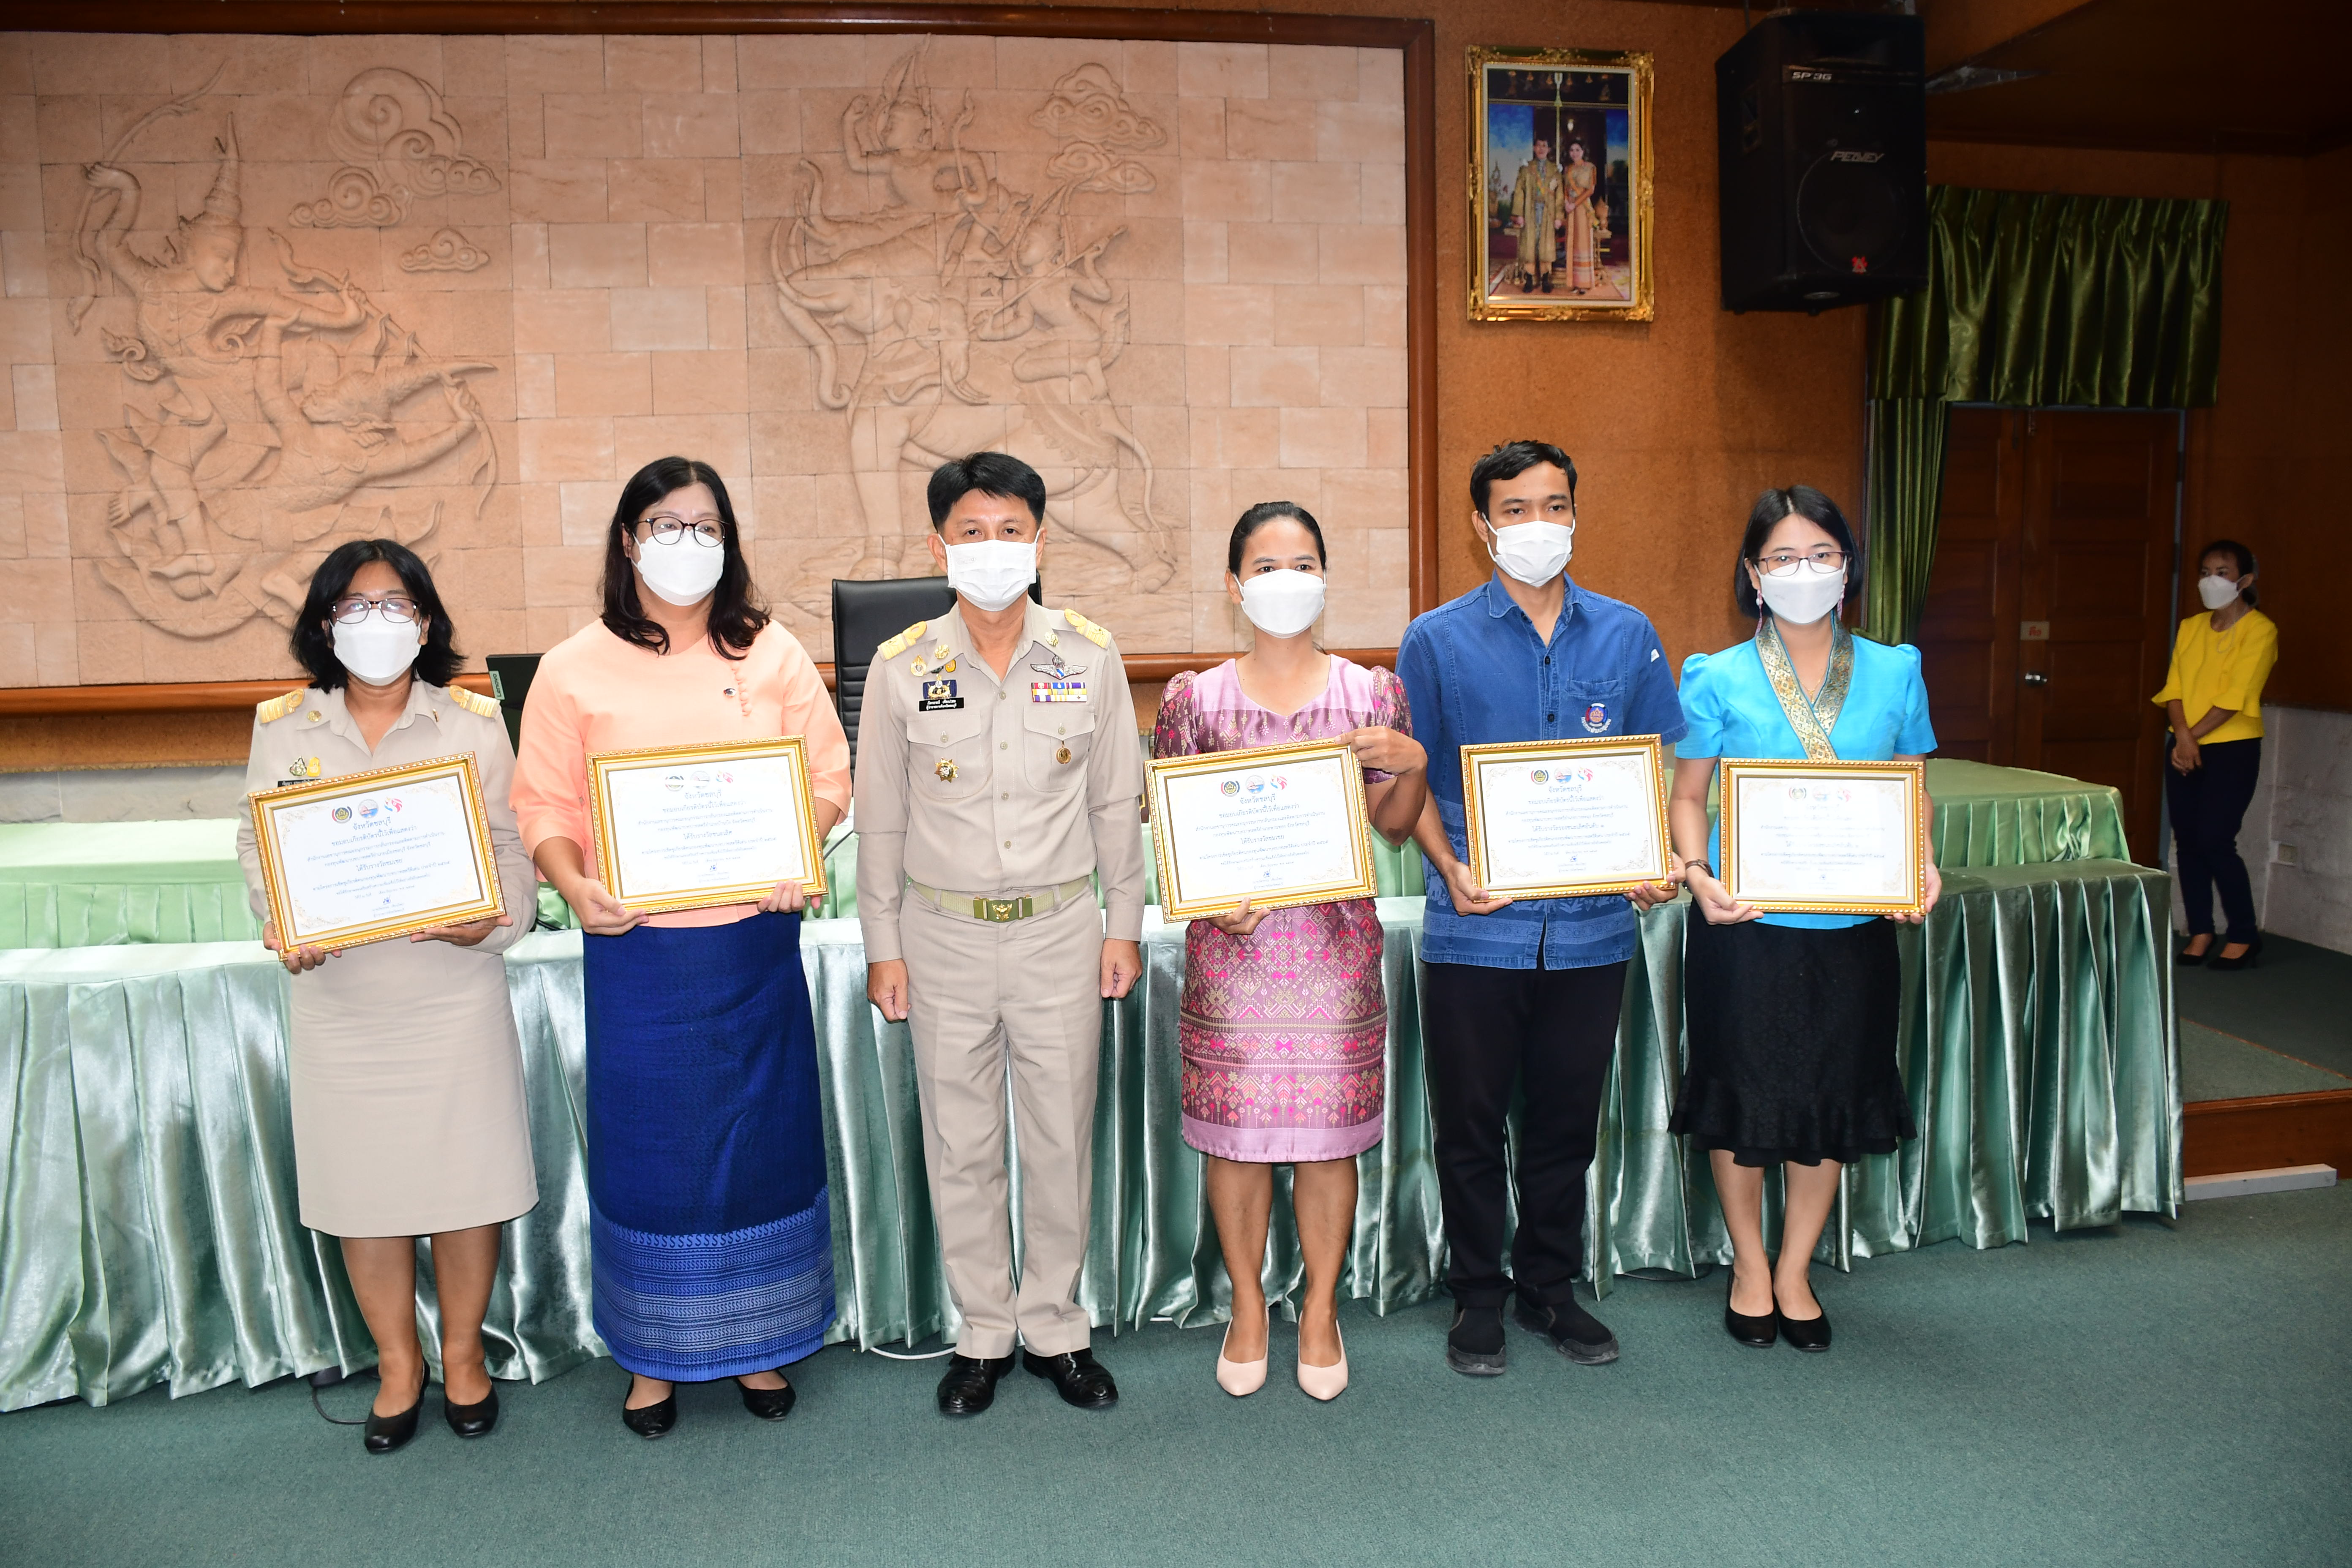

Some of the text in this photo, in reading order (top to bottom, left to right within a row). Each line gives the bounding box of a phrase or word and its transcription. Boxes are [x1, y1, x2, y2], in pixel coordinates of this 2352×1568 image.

[1792, 71, 1812, 80] SP
[1830, 150, 1885, 163] PEAVEY
[493, 673, 502, 697] Lenovo
[684, 789, 722, 801] จังหวัดชลบุรี
[1549, 784, 1582, 795] จังหวัดชลบุรี
[1239, 793, 1276, 806] จังหวัดชลบุรี
[1219, 802, 1299, 818] ขอมอบเกียรติบัตรนี้ไว้เพื่อแสดงว่า
[352, 816, 392, 832] จังหวัดชลบุรี
[331, 824, 417, 847] ขอมอบเกียรติบัตรนี้ไว้เพื่อแสดงว่า
[683, 828, 732, 840] ได้รับรางวัลชนะเลิศ
[1240, 833, 1284, 844] ได้รับรางวัลชมเชย
[356, 856, 403, 872] ได้รับรางวัลชมเชย
